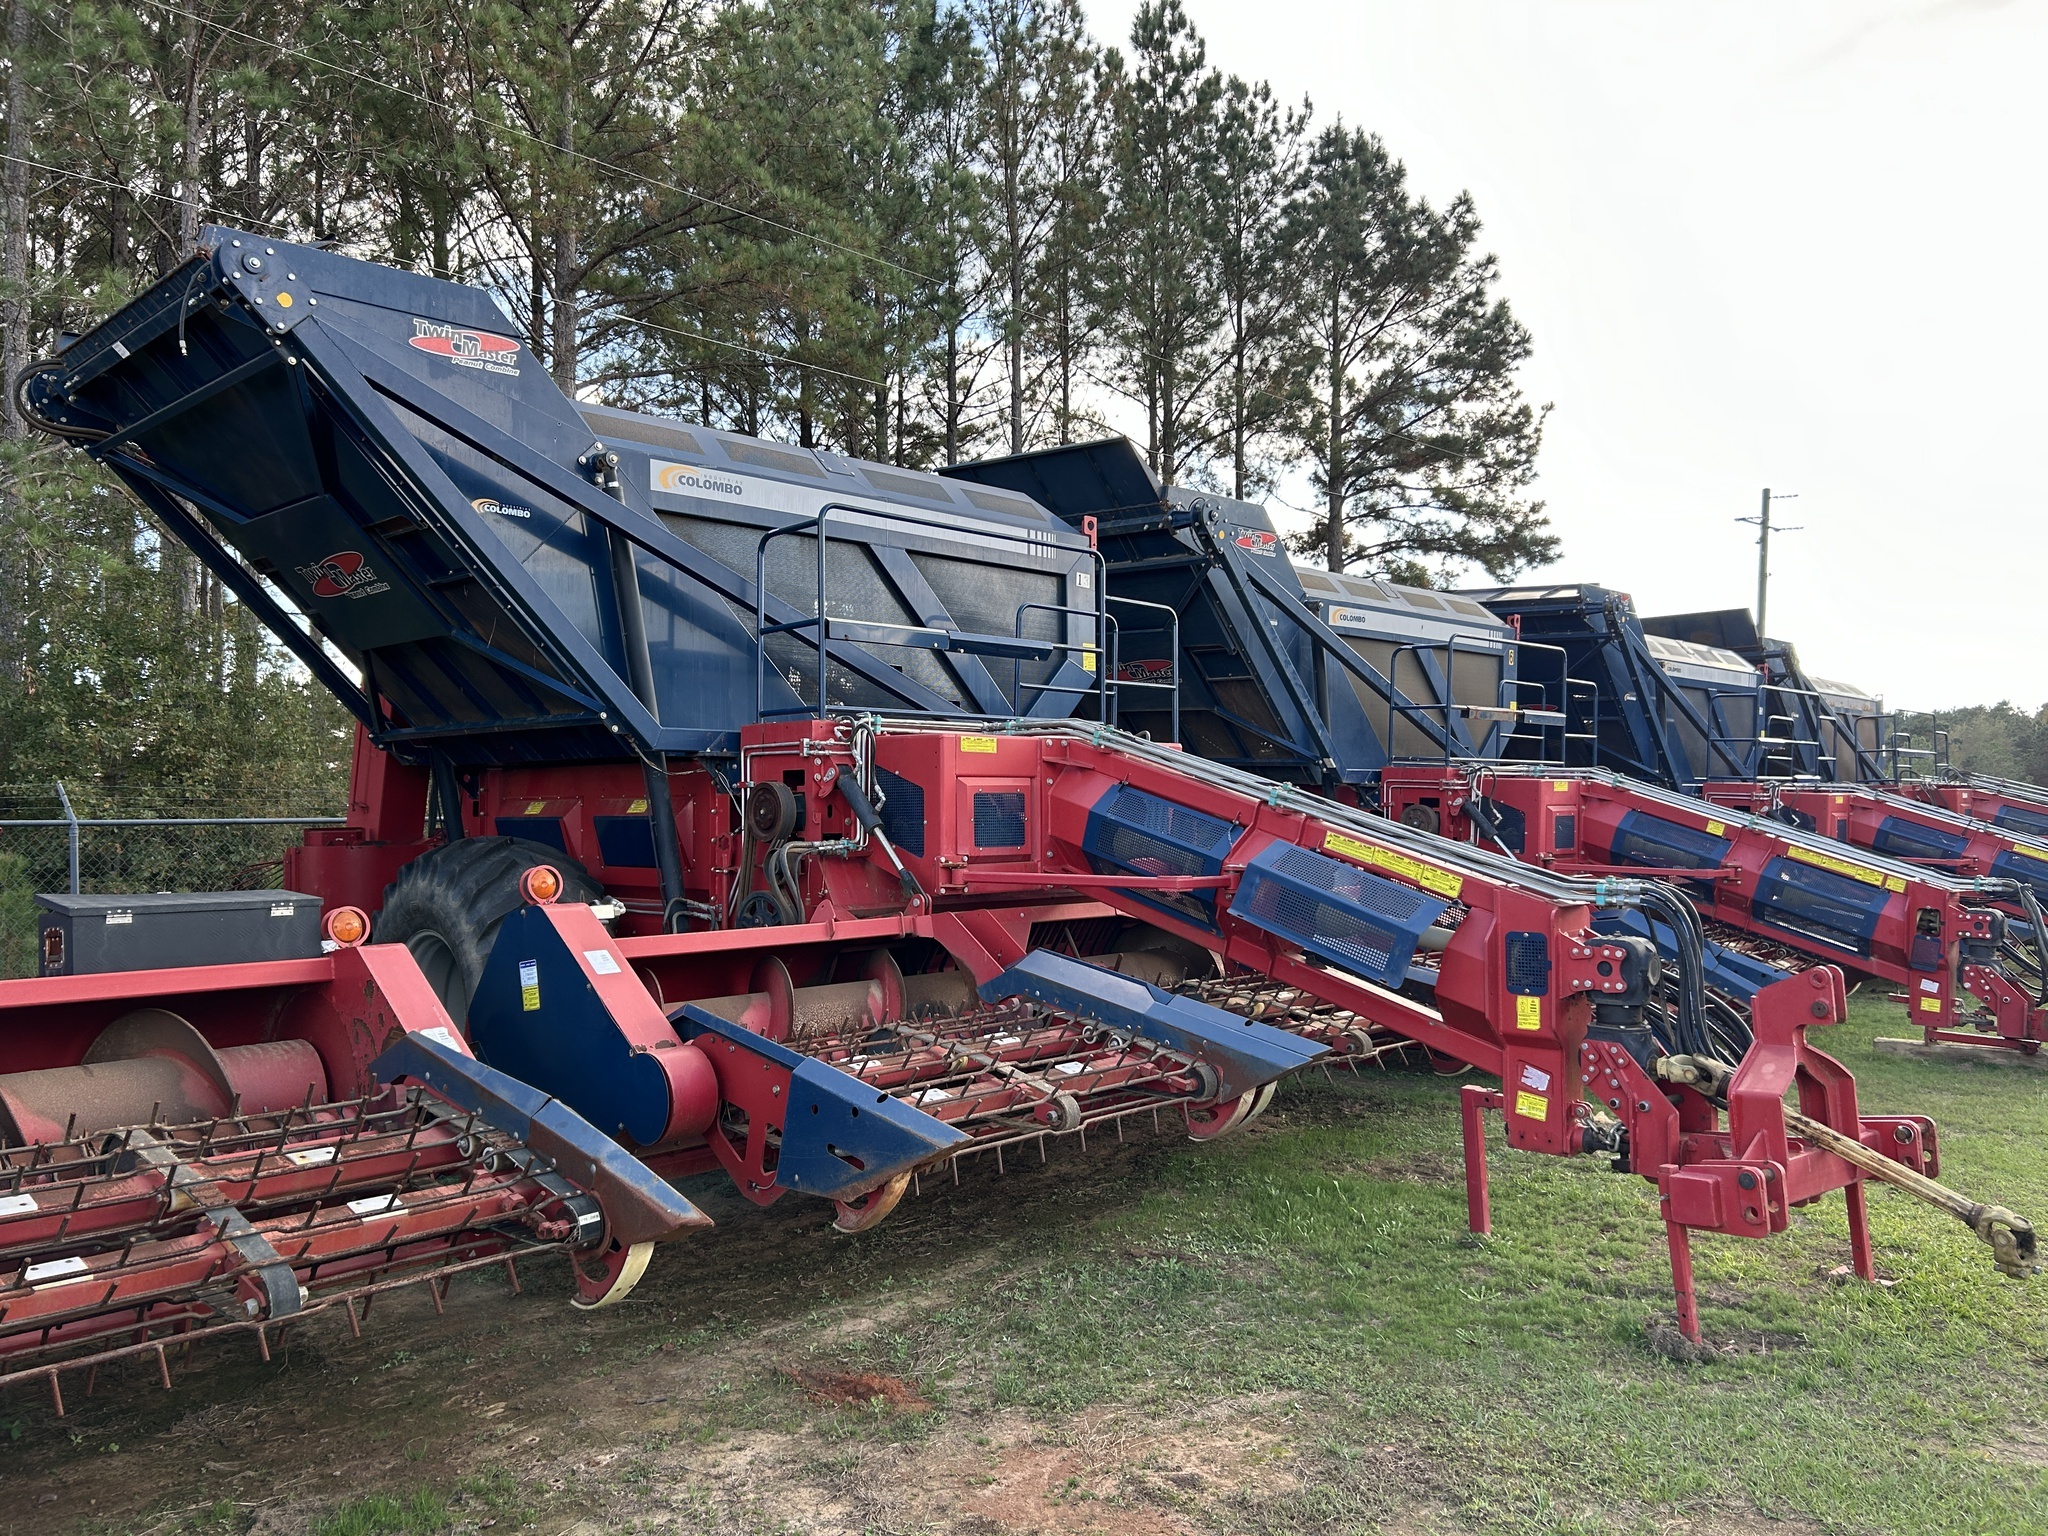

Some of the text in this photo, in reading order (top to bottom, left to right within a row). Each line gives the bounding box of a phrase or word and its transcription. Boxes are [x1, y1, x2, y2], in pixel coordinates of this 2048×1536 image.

[413, 318, 464, 344] Twin
[460, 339, 517, 366] Master
[451, 356, 521, 377] Peanut Combine
[678, 474, 743, 496] COLOMBO
[484, 504, 531, 519] COLOMBO
[1340, 613, 1366, 624] COLOMBO
